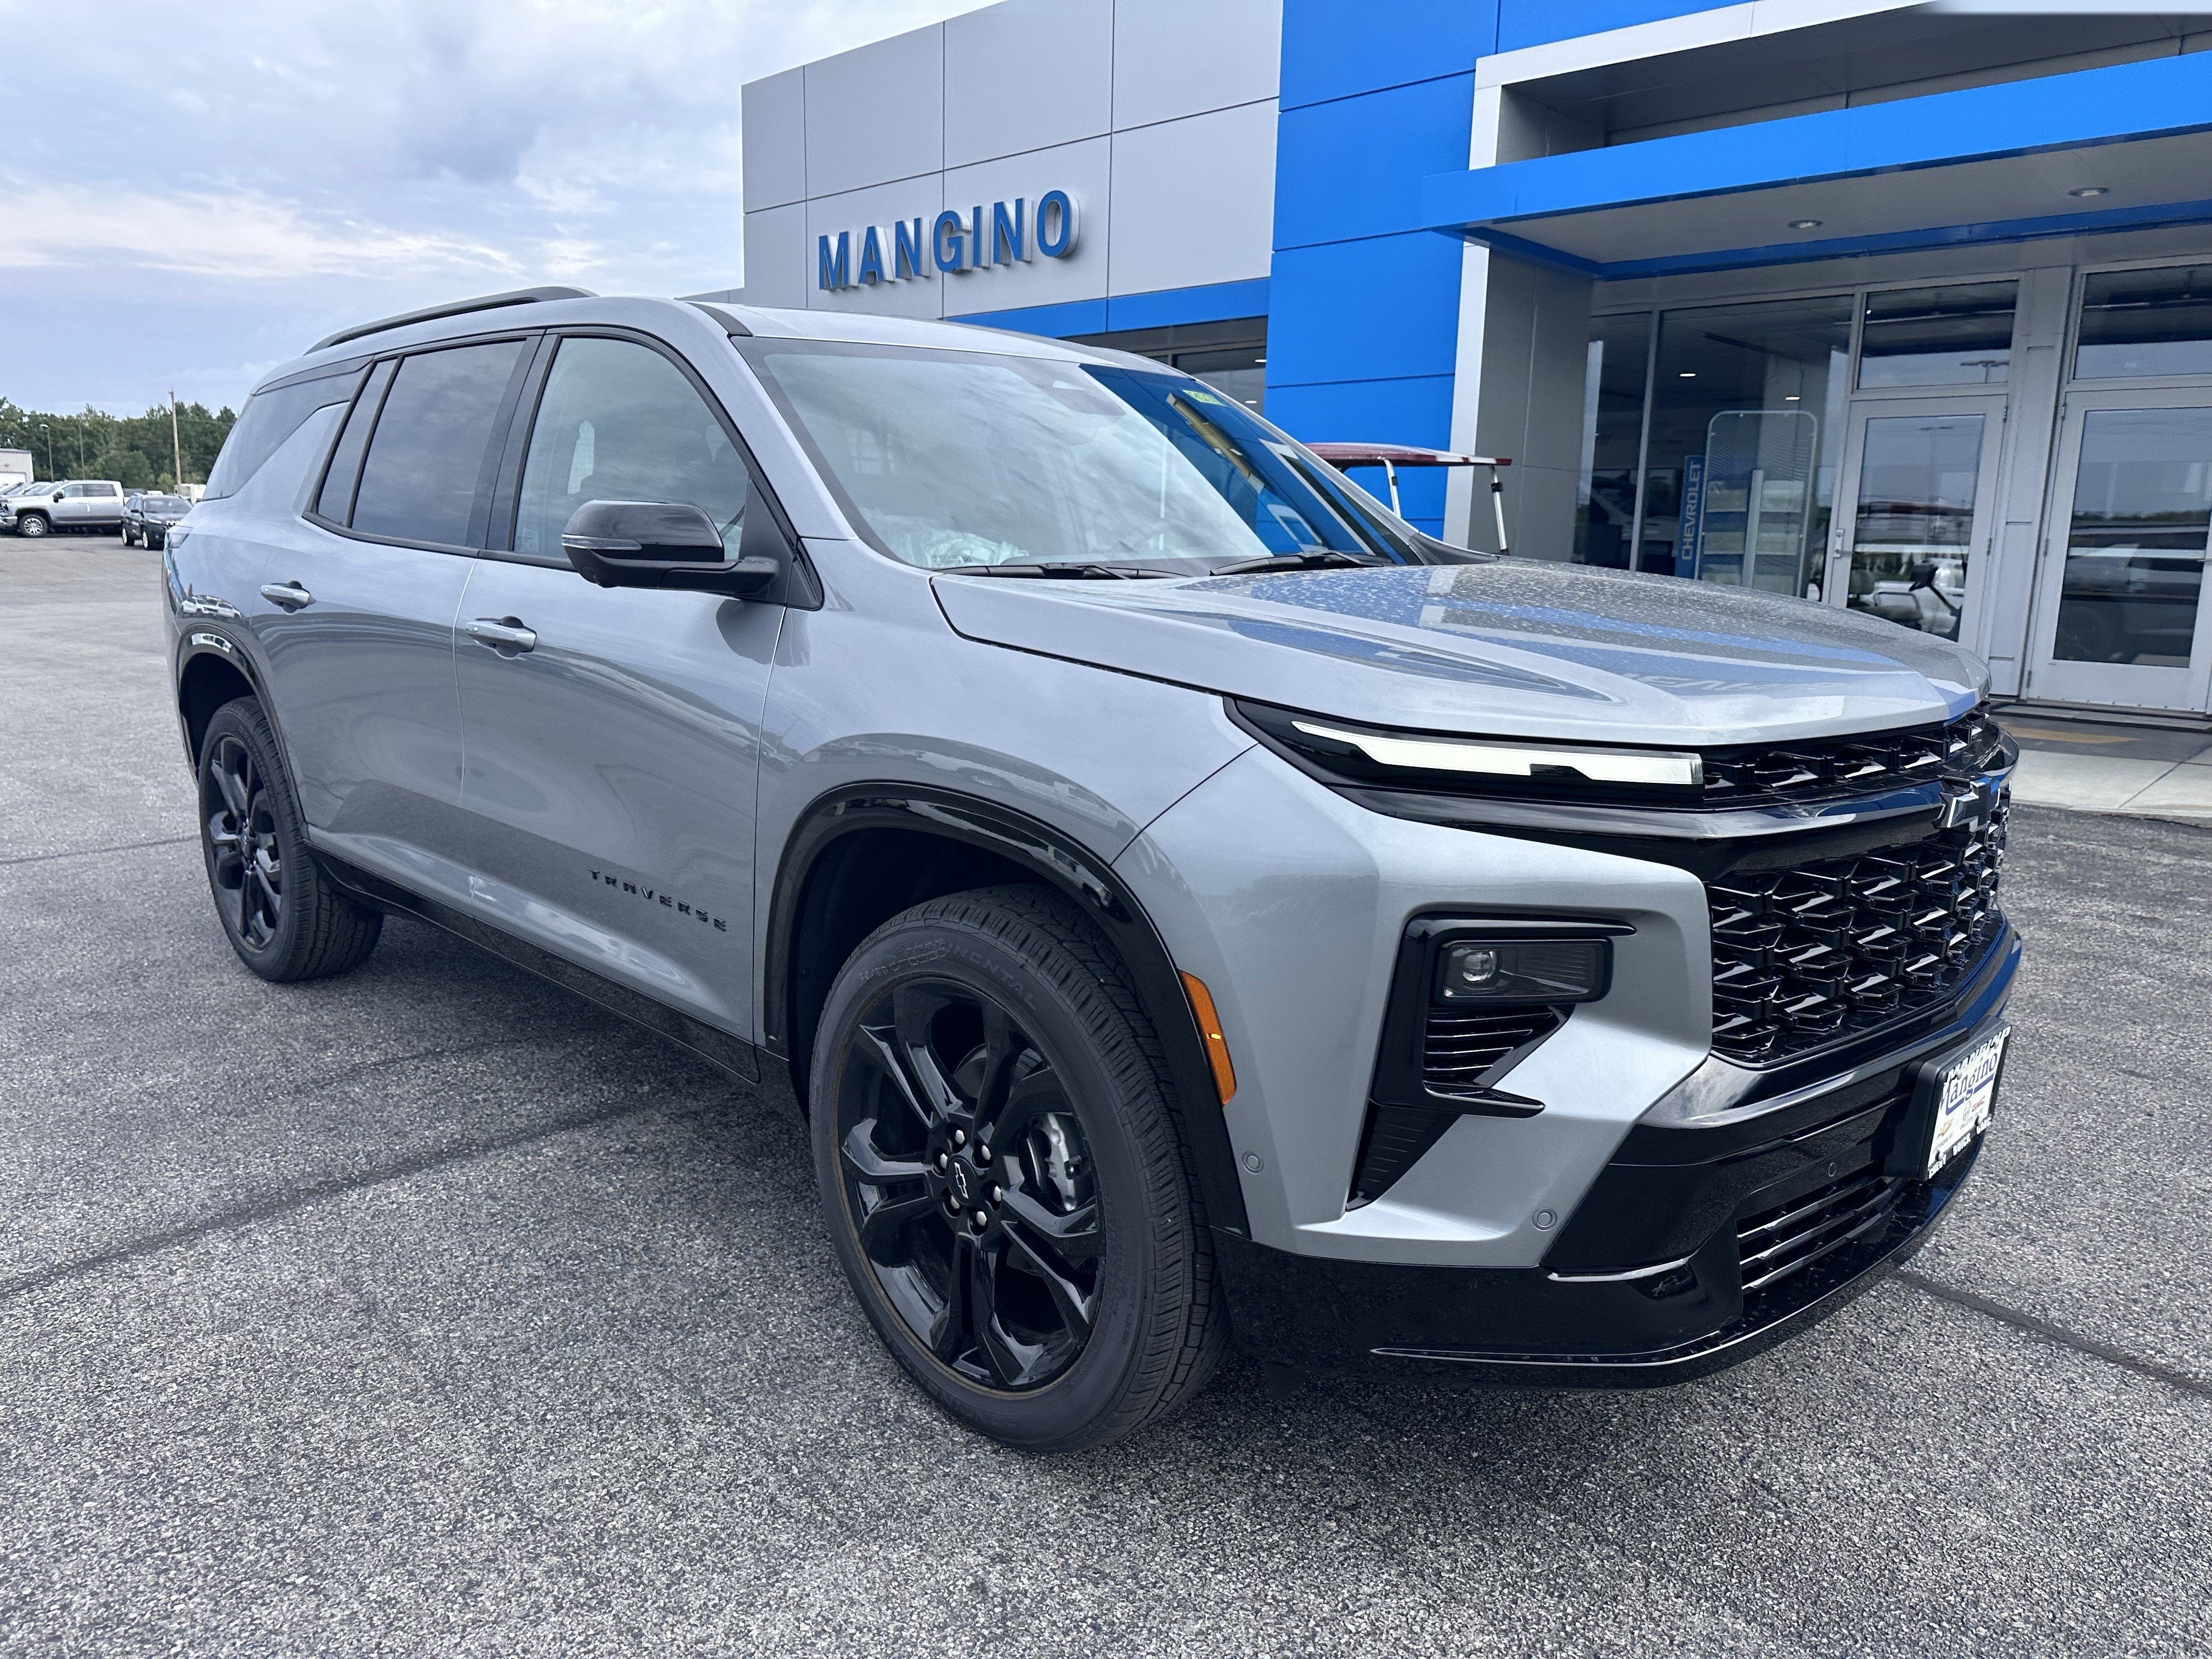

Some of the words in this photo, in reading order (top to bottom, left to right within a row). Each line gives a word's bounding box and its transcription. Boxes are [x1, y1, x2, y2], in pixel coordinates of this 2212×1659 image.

[819, 190, 1076, 290] MANGINO
[1681, 461, 1701, 560] CHEVROLET
[588, 868, 726, 932] TRAVERSE
[892, 940, 1037, 1011] CINENTAL
[1953, 1132, 1971, 1156] BUICK
